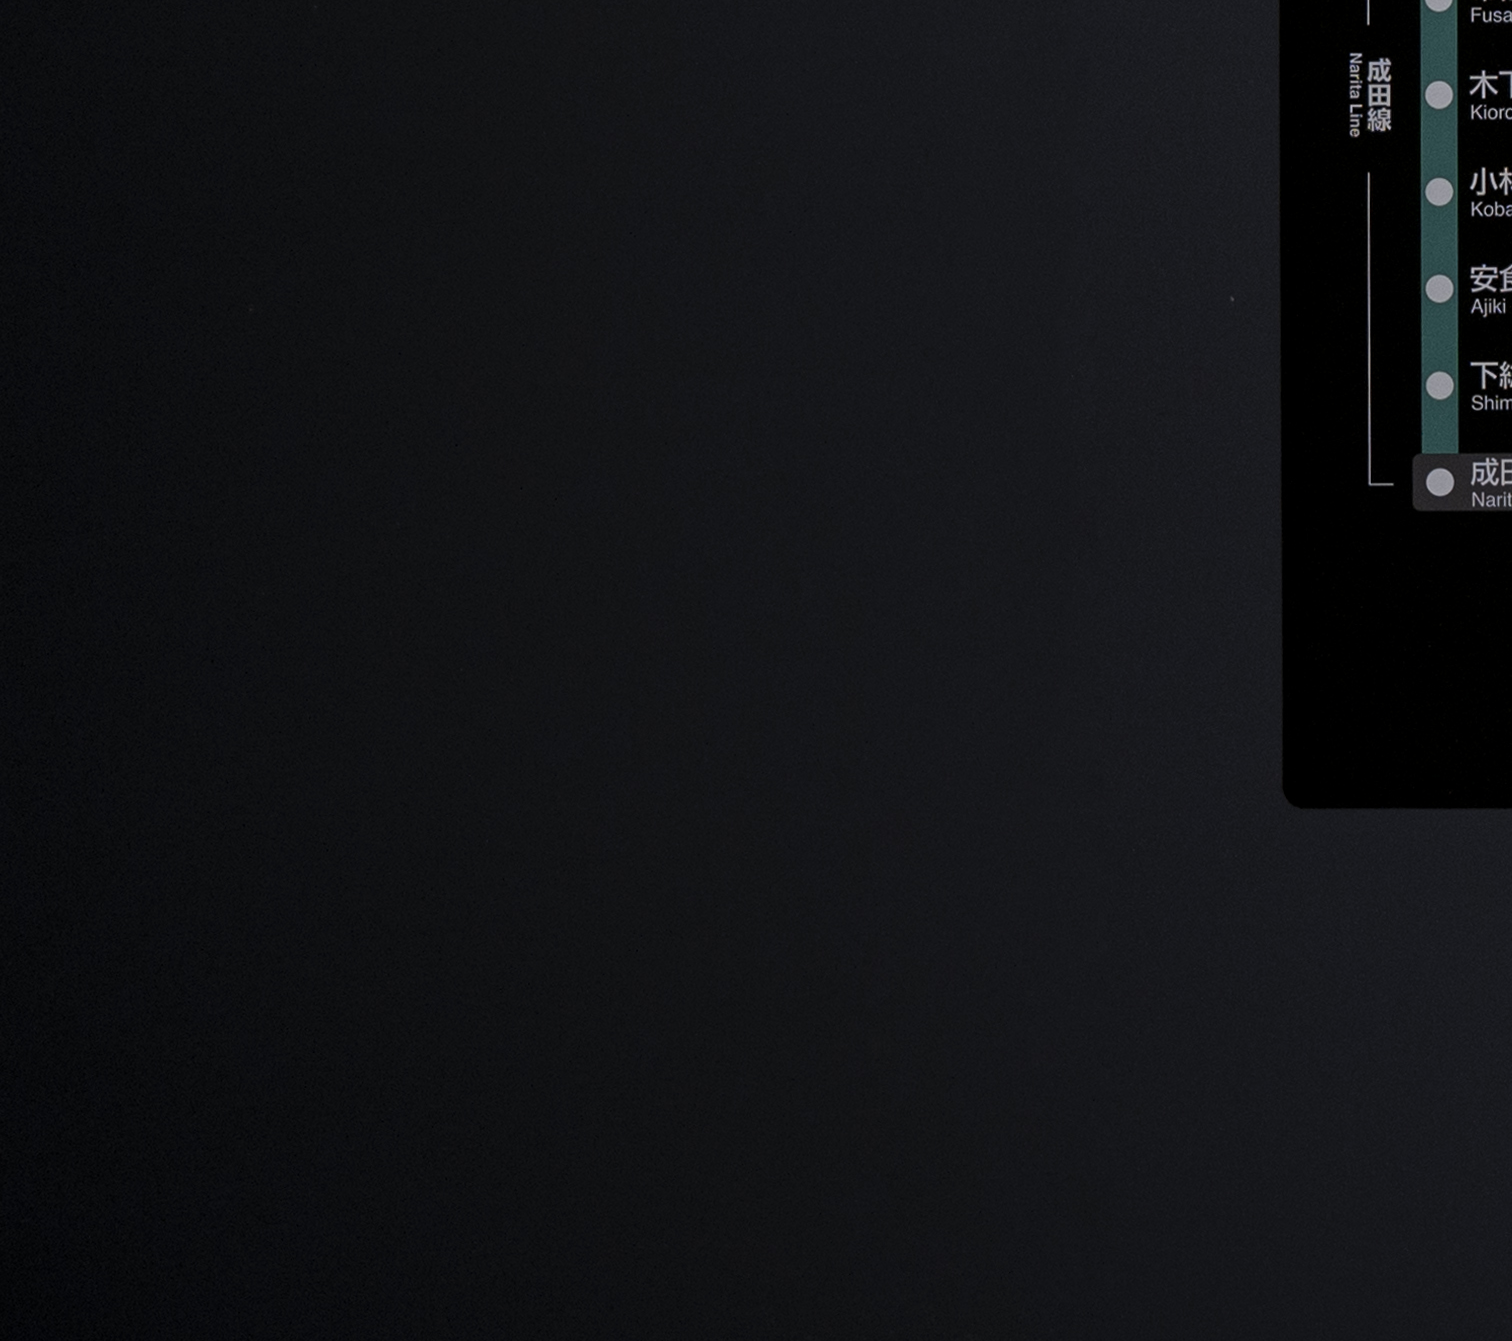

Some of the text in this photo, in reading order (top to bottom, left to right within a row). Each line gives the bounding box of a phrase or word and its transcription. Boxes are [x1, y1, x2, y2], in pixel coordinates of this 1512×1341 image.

[1471, 7, 1512, 23] Fusa
[1350, 53, 1363, 137] Narita Line
[1367, 58, 1391, 132] 成田線
[1471, 298, 1505, 317] Ajiki
